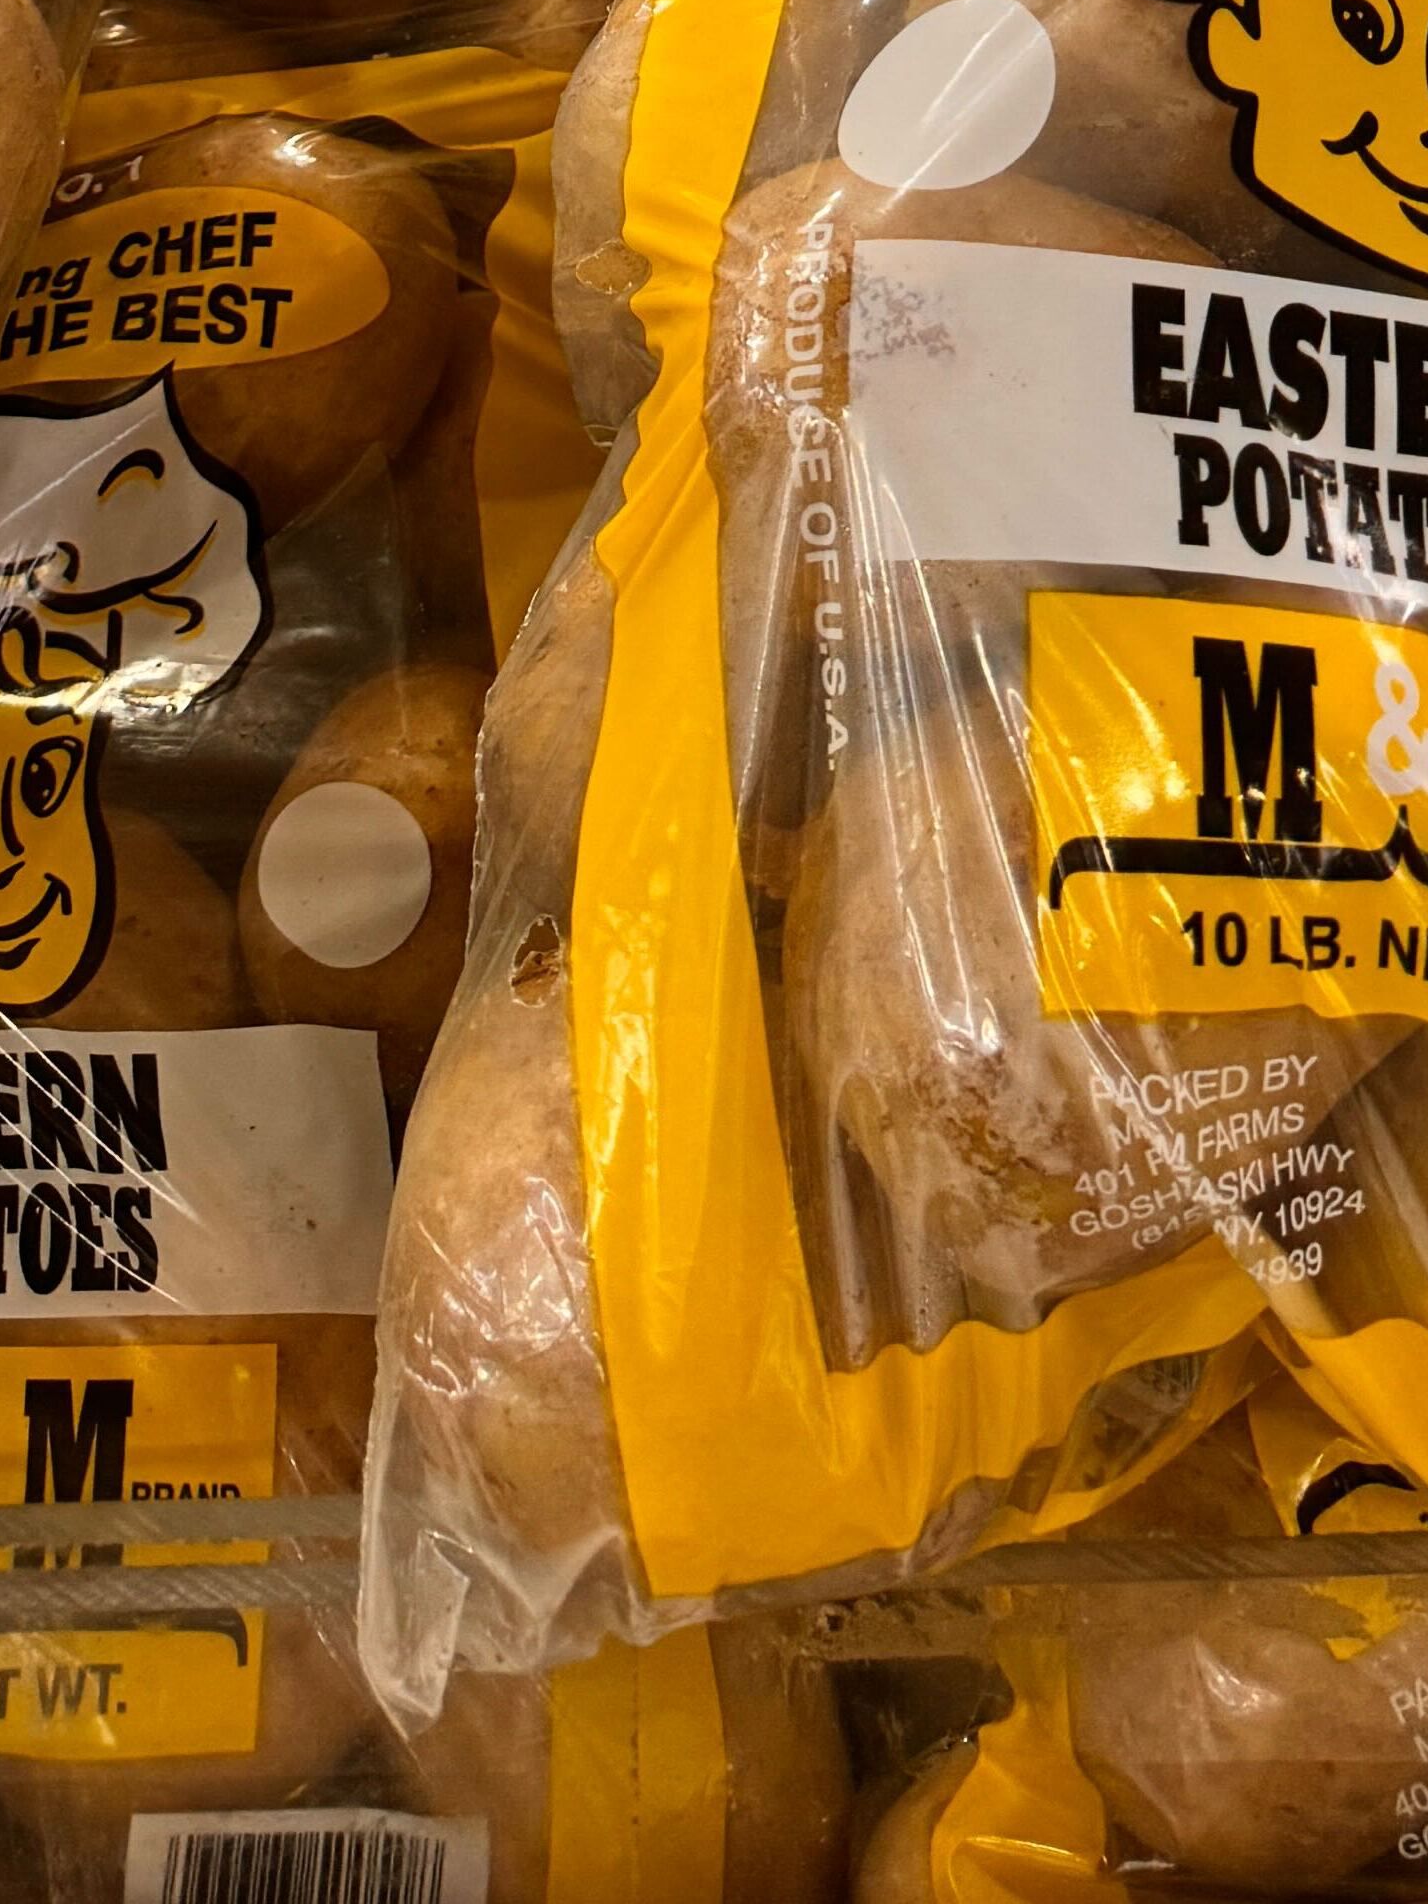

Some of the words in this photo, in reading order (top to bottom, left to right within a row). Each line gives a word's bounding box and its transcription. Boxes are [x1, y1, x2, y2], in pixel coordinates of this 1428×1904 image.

[108, 211, 277, 280] CHEF
[111, 282, 293, 349] BEST
[783, 221, 833, 490] PRODUCE
[800, 500, 840, 586] OF
[814, 600, 850, 773] U.S.A.
[1192, 635, 1324, 844] M
[1179, 910, 1250, 970] 10
[1267, 913, 1358, 972] LB.
[1090, 1065, 1249, 1116] PACKED
[1262, 1054, 1318, 1093] BY
[1196, 1103, 1305, 1162] FARMS
[1073, 1162, 1136, 1197] 401
[1271, 1144, 1355, 1186] HWY
[1275, 1187, 1366, 1237] 10924
[36, 1662, 128, 1718] WT.
